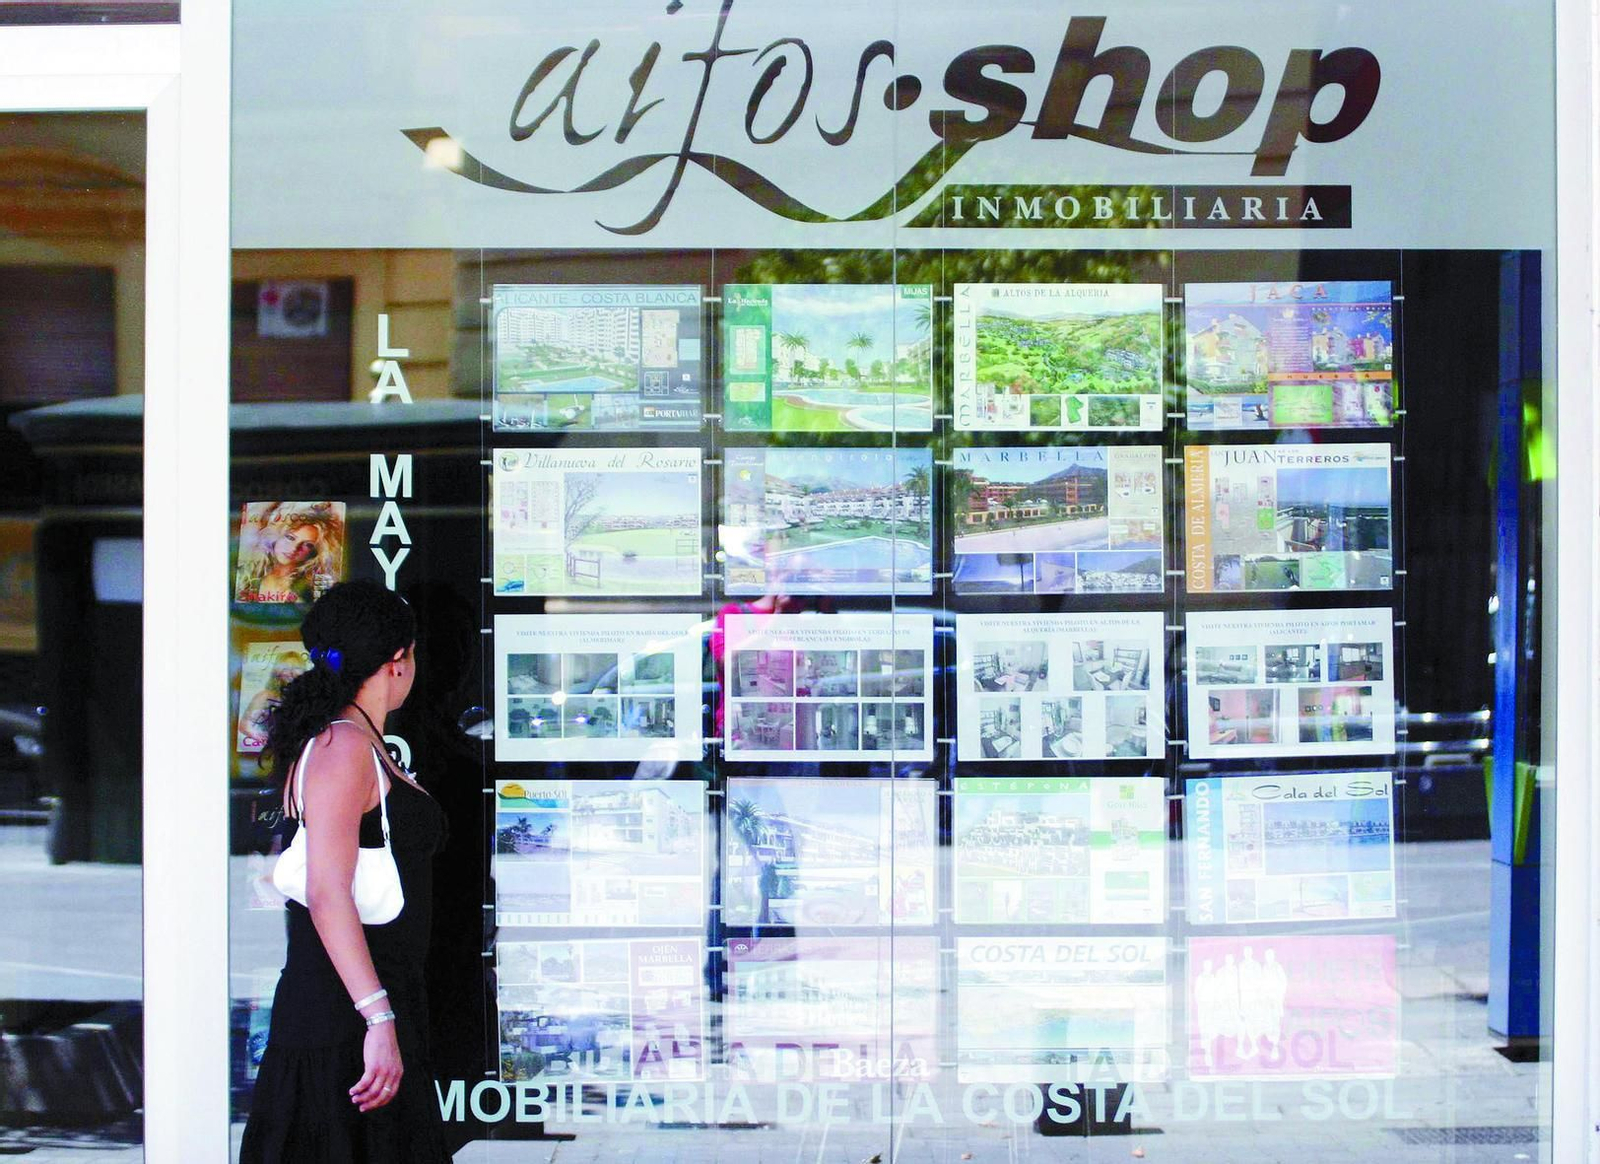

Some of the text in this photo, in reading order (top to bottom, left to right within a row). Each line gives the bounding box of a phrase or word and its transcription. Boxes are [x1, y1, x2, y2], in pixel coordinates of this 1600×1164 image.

[929, 15, 1382, 178] shop
[951, 195, 1326, 222] INMOBILIARIA
[581, 292, 630, 305] COSTA
[636, 292, 697, 304] BLANCA
[1002, 289, 1032, 297] ALTOS
[1034, 289, 1046, 297] DE
[1048, 289, 1060, 297] LA
[1251, 284, 1329, 302] JACA
[369, 314, 413, 404] LA
[523, 451, 697, 469] Villanueva del Rosario
[959, 451, 1104, 463] MARBELLA
[1224, 449, 1277, 466] JUAN
[1278, 454, 1350, 464] TERREROS
[369, 454, 412, 600] MAY
[1191, 520, 1206, 537] DE
[1191, 543, 1206, 590] COSTA
[1252, 780, 1389, 800] Cala del Sol
[1195, 781, 1213, 922] SAN FERNANDO
[970, 944, 1151, 963] COSTA DEL SOL
[832, 1047, 931, 1077] Baeza
[776, 1081, 851, 1123] DE
[872, 1081, 945, 1123] LA
[962, 1080, 1154, 1124] COSTA
[1172, 1081, 1283, 1122] DEL
[1299, 1079, 1414, 1121] SOL
